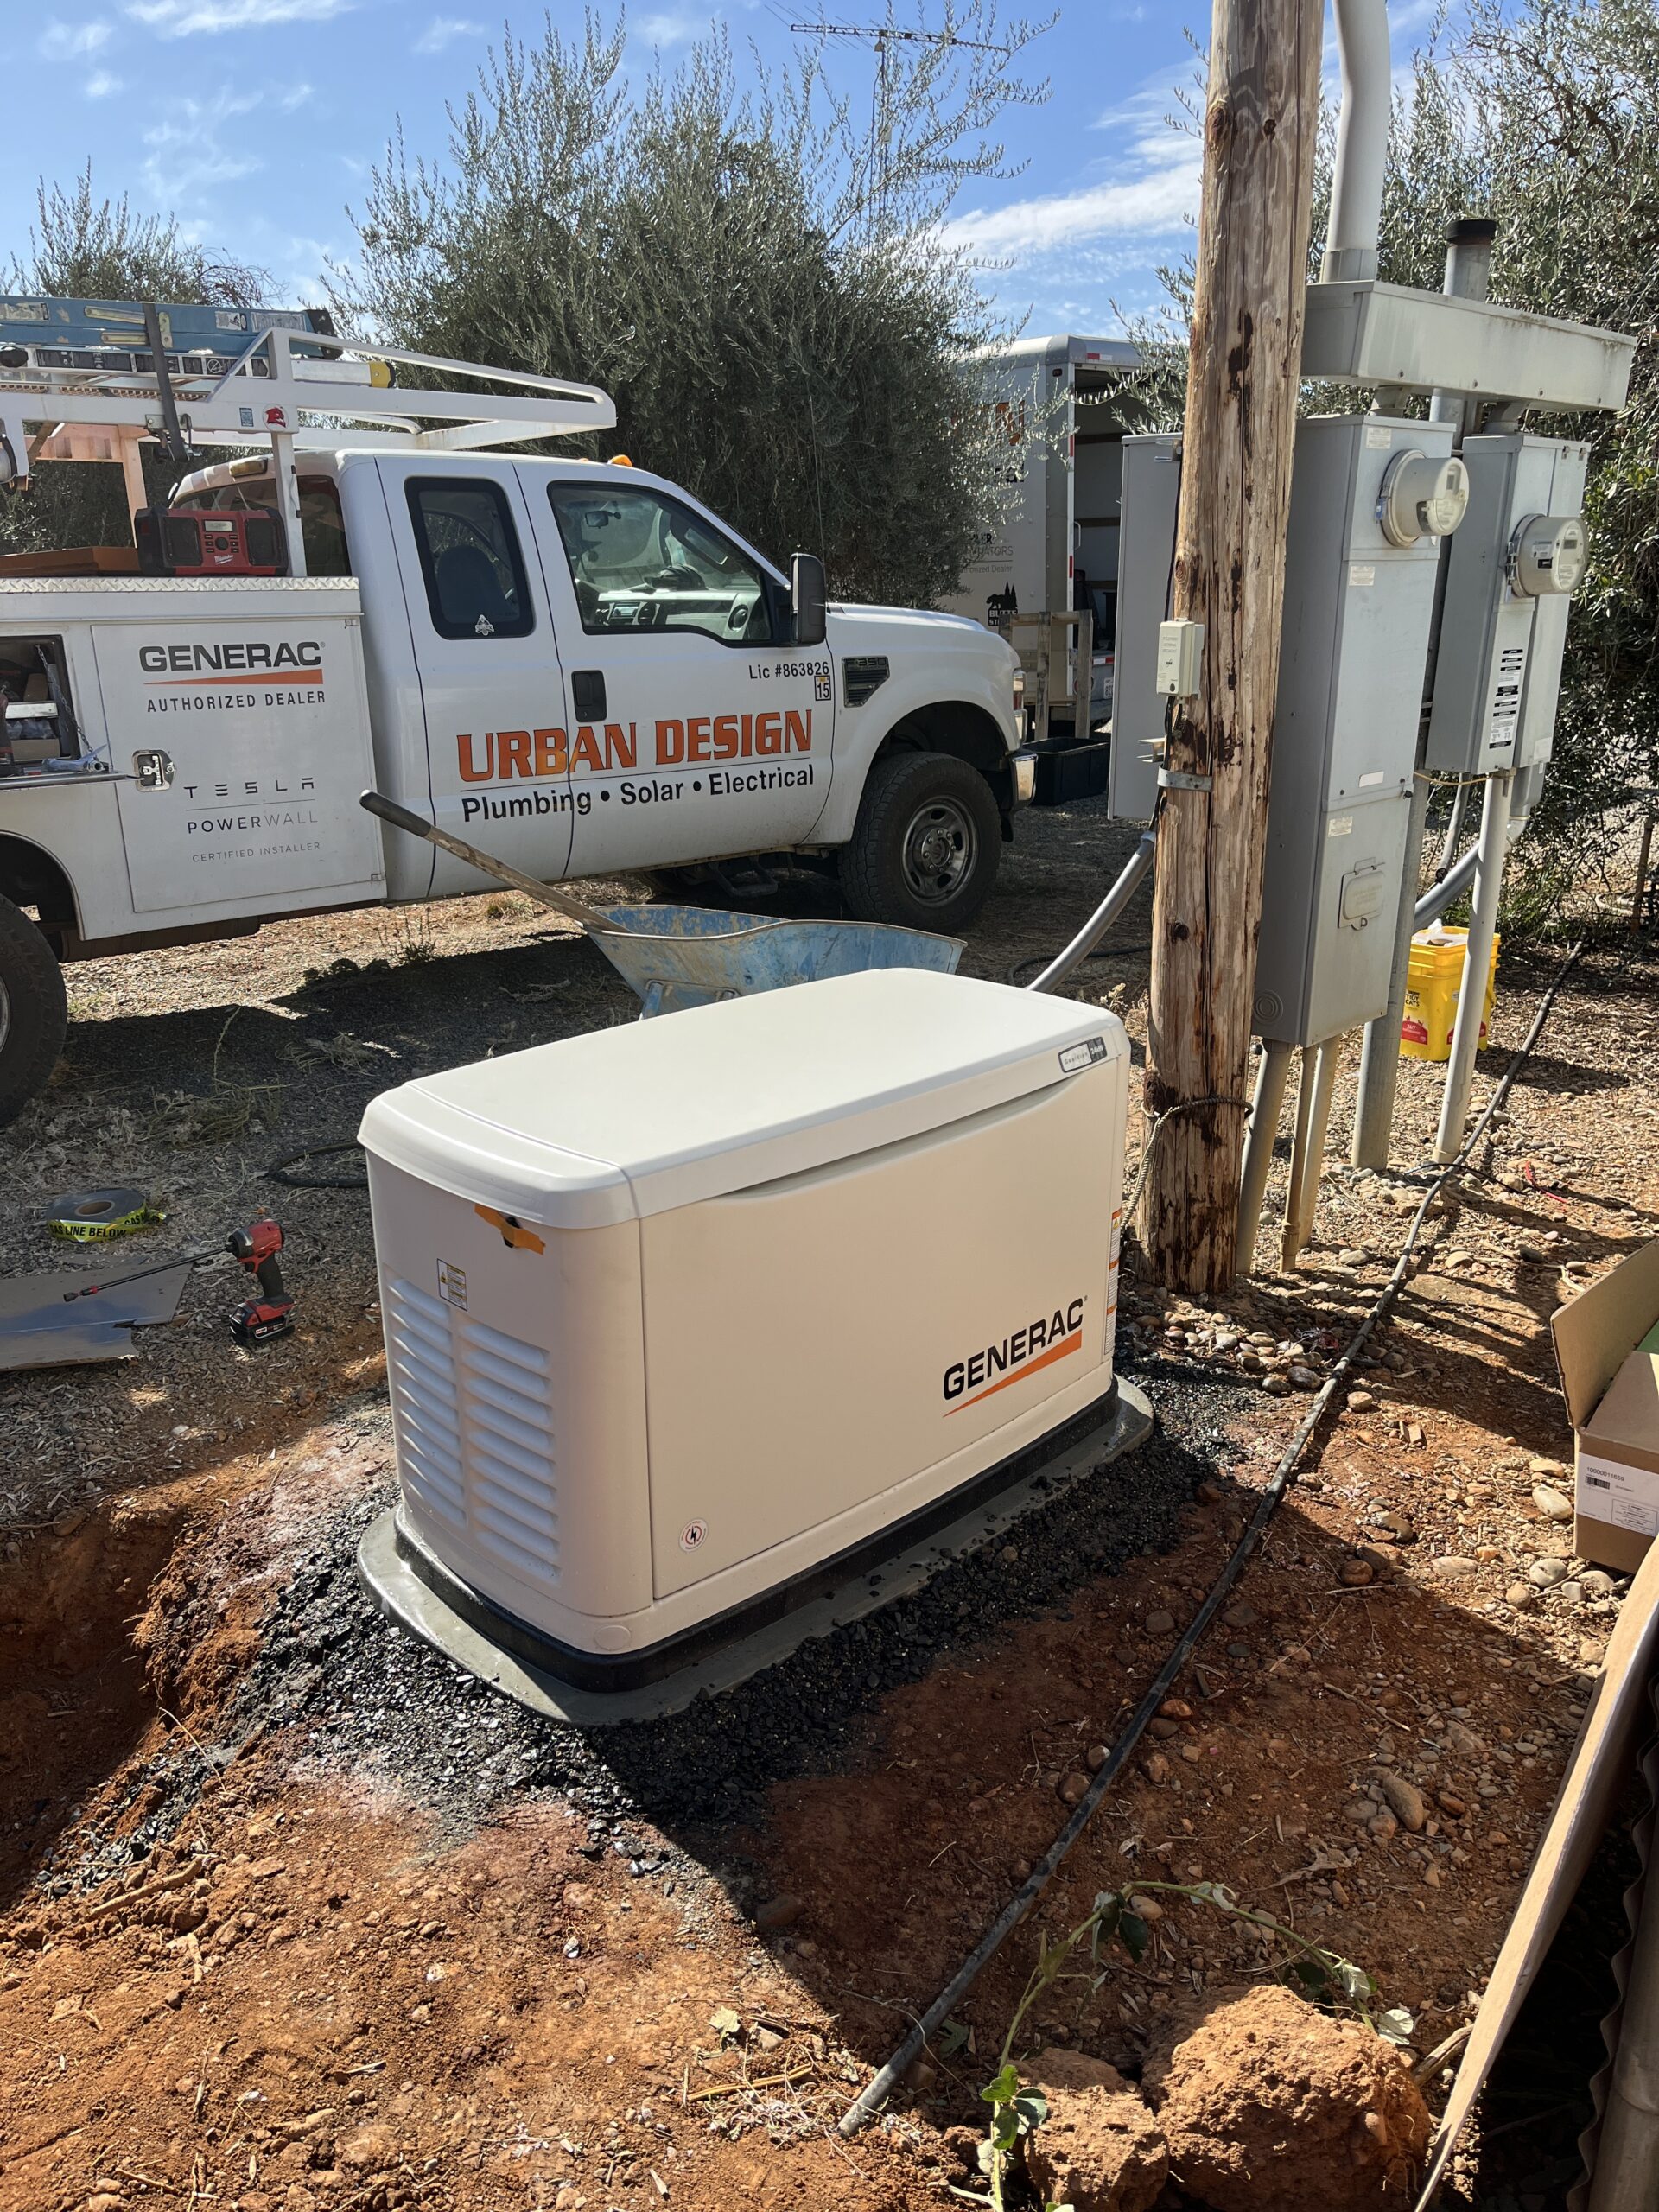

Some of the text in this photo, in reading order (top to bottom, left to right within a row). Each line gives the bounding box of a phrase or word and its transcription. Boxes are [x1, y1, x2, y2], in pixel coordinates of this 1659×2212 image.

[139, 641, 321, 672] GENERAC
[748, 661, 830, 679] Lic #863826
[147, 690, 327, 713] AUTHORIZED DEALER
[817, 682, 830, 698] 15
[456, 709, 813, 783] URBAN DESIGN
[183, 777, 315, 798] TESLA
[461, 764, 815, 822] Plumbing Solar Electrical
[187, 810, 319, 834] POWERWALL
[192, 842, 321, 862] CERTIFIED INSTALLER
[65, 1225, 86, 1236] LINE
[88, 1227, 127, 1238] BELOW
[943, 1297, 1084, 1401] GENERAC
